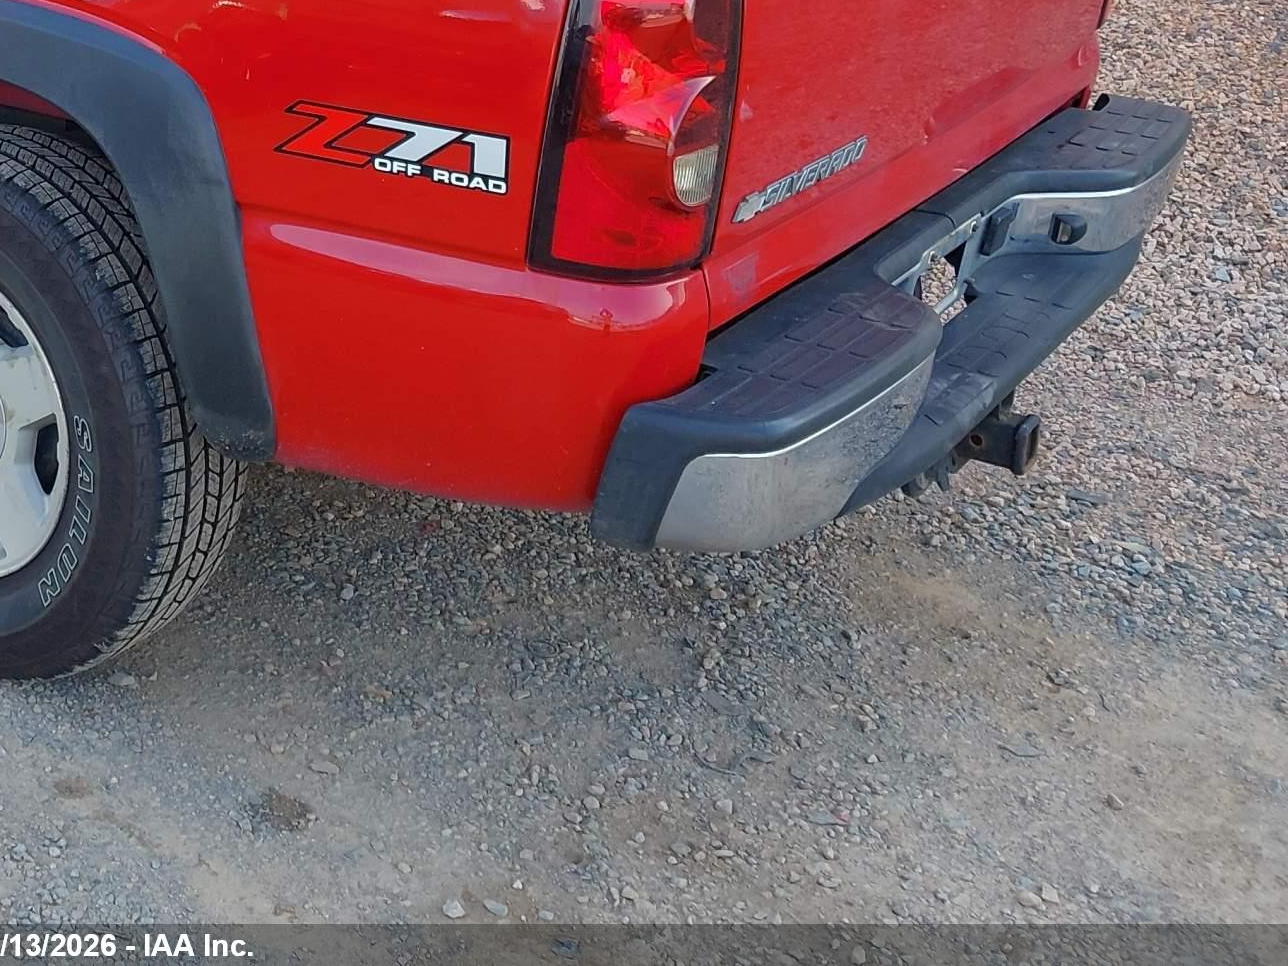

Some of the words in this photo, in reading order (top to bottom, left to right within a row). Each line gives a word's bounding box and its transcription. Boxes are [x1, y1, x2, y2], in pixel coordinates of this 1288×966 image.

[273, 99, 510, 178] Z71
[373, 157, 421, 177] OFF
[432, 169, 508, 195] ROAD
[761, 135, 869, 212] SILVERADO
[38, 415, 95, 608] SAILUN
